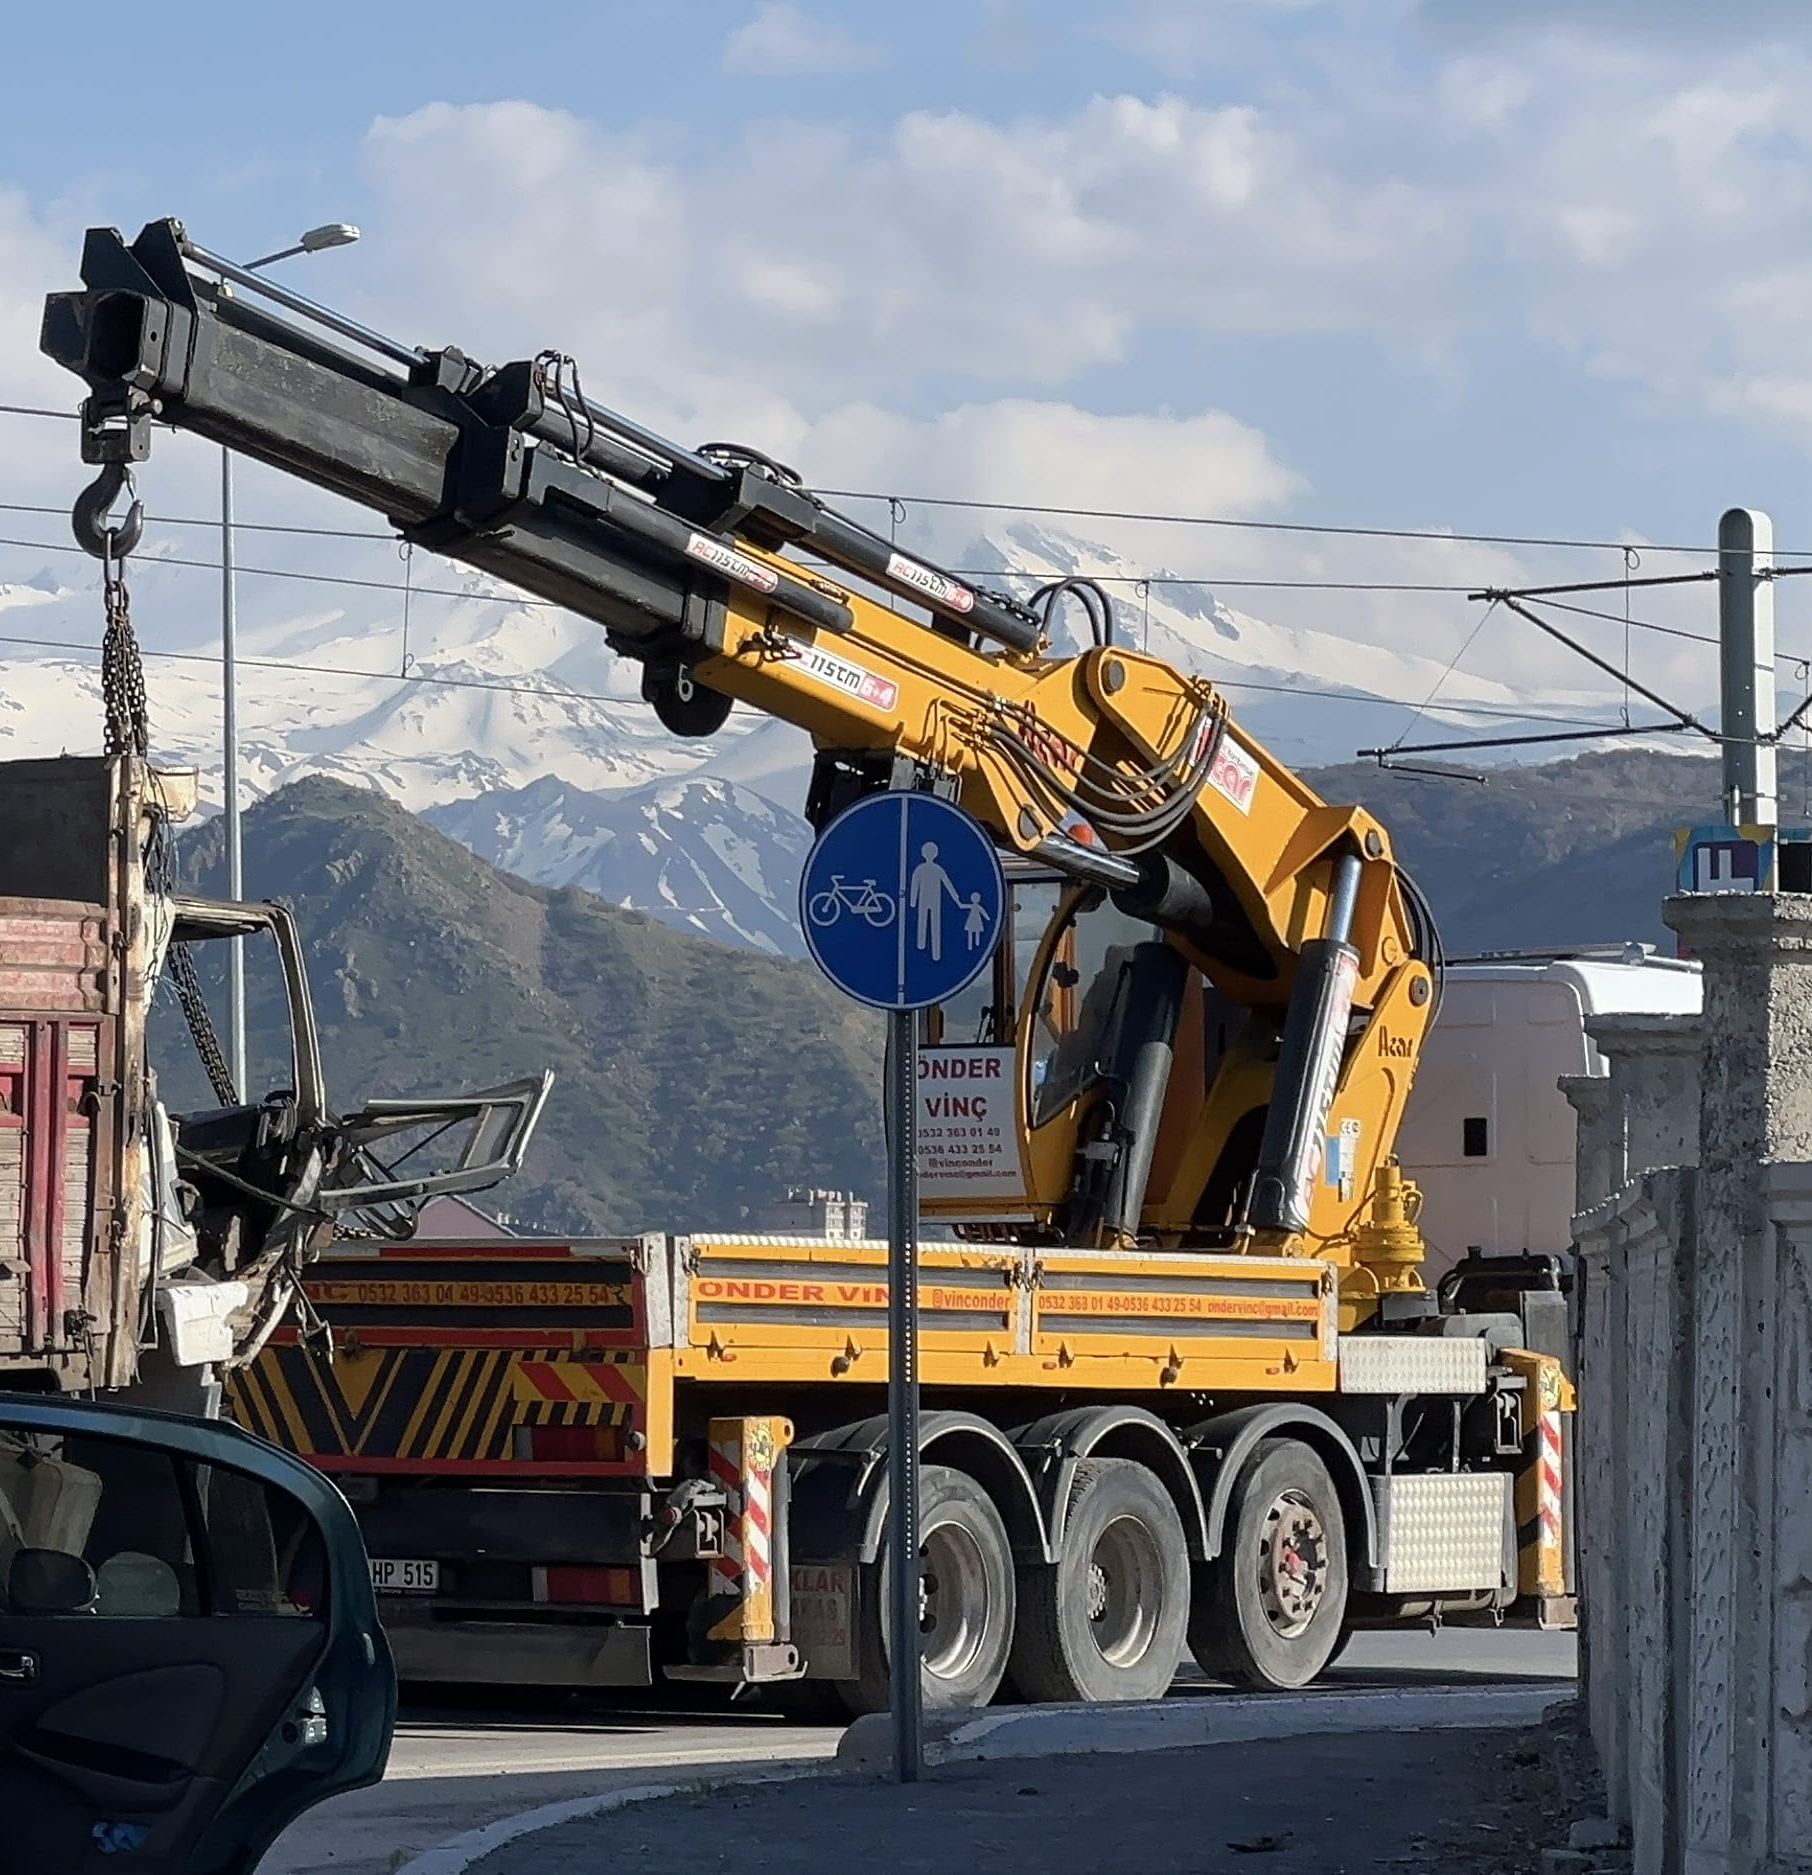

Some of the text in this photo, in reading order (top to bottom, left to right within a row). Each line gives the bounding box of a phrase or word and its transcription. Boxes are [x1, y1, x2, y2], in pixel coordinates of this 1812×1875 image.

[1378, 1025, 1413, 1058] Acar
[924, 1092, 988, 1122] VİNÇ
[970, 1127, 983, 1138] 01
[948, 1144, 968, 1155] 433
[972, 1144, 986, 1154] 25
[358, 1283, 396, 1301] 0532
[402, 1284, 431, 1301] 363
[529, 1284, 559, 1304] 433
[563, 1284, 584, 1304] 25
[589, 1284, 610, 1305] 54
[931, 1288, 1011, 1310] @vinconder
[1038, 1295, 1066, 1310] 0532
[1068, 1295, 1088, 1311] 363
[1091, 1296, 1104, 1311] 01
[1152, 1297, 1171, 1312] 433
[1171, 1297, 1186, 1312] 25
[1188, 1297, 1202, 1313] 54
[372, 1561, 433, 1586] HP 515
